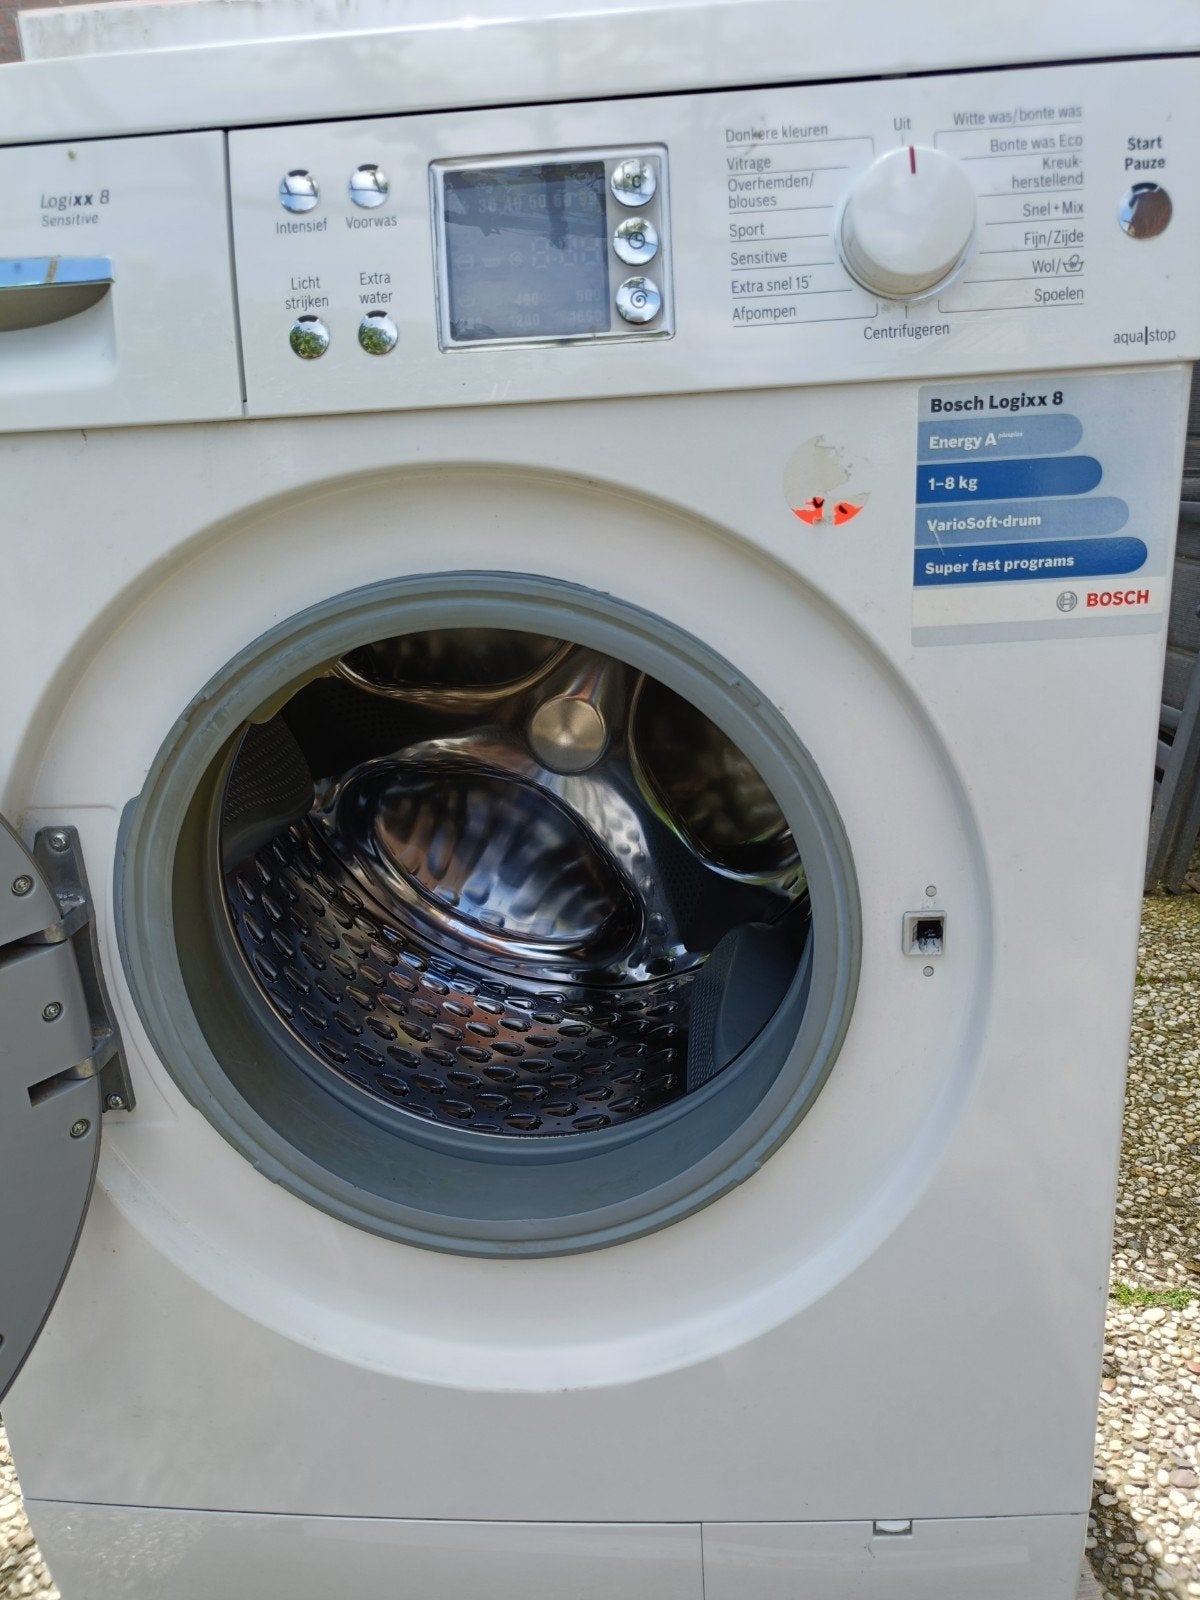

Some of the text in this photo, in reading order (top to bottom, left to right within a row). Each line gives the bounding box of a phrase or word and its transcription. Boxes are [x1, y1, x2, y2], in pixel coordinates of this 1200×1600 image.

[893, 118, 912, 132] Uit
[953, 111, 986, 126] Witte
[1058, 106, 1082, 119] was
[725, 124, 828, 143] Donkere kleuren
[1127, 135, 1163, 150] Start
[990, 134, 1083, 153] Bonte was Eco
[726, 156, 771, 172] Vitrage
[1124, 156, 1166, 171] Pauze
[727, 172, 815, 192] Overhemden/
[1012, 172, 1084, 189] herstellend
[40, 189, 110, 211] Logixx 8
[728, 194, 777, 209] blouses
[41, 212, 99, 228] Sensitive
[275, 217, 328, 235] Intensief
[345, 214, 398, 230] Voorwas
[729, 222, 765, 240] Sport
[730, 250, 788, 266] Sensitive
[290, 275, 321, 291] Licht
[359, 271, 391, 287] Extra
[731, 279, 764, 294] Extra
[766, 276, 792, 291] snel
[285, 293, 329, 312] strijken
[359, 289, 393, 305] water
[1034, 286, 1084, 304] Spoelen
[732, 305, 796, 322] Afpompen
[863, 322, 950, 341] Centrifugeren
[930, 391, 1064, 413] Bosch Logixx 8
[928, 435, 982, 451] Energy
[984, 432, 997, 447] A
[959, 475, 979, 492] kg
[927, 514, 1042, 532] VarioSoft-drum
[925, 555, 1075, 576] Super fast programs
[1086, 589, 1150, 608] BOSCH
